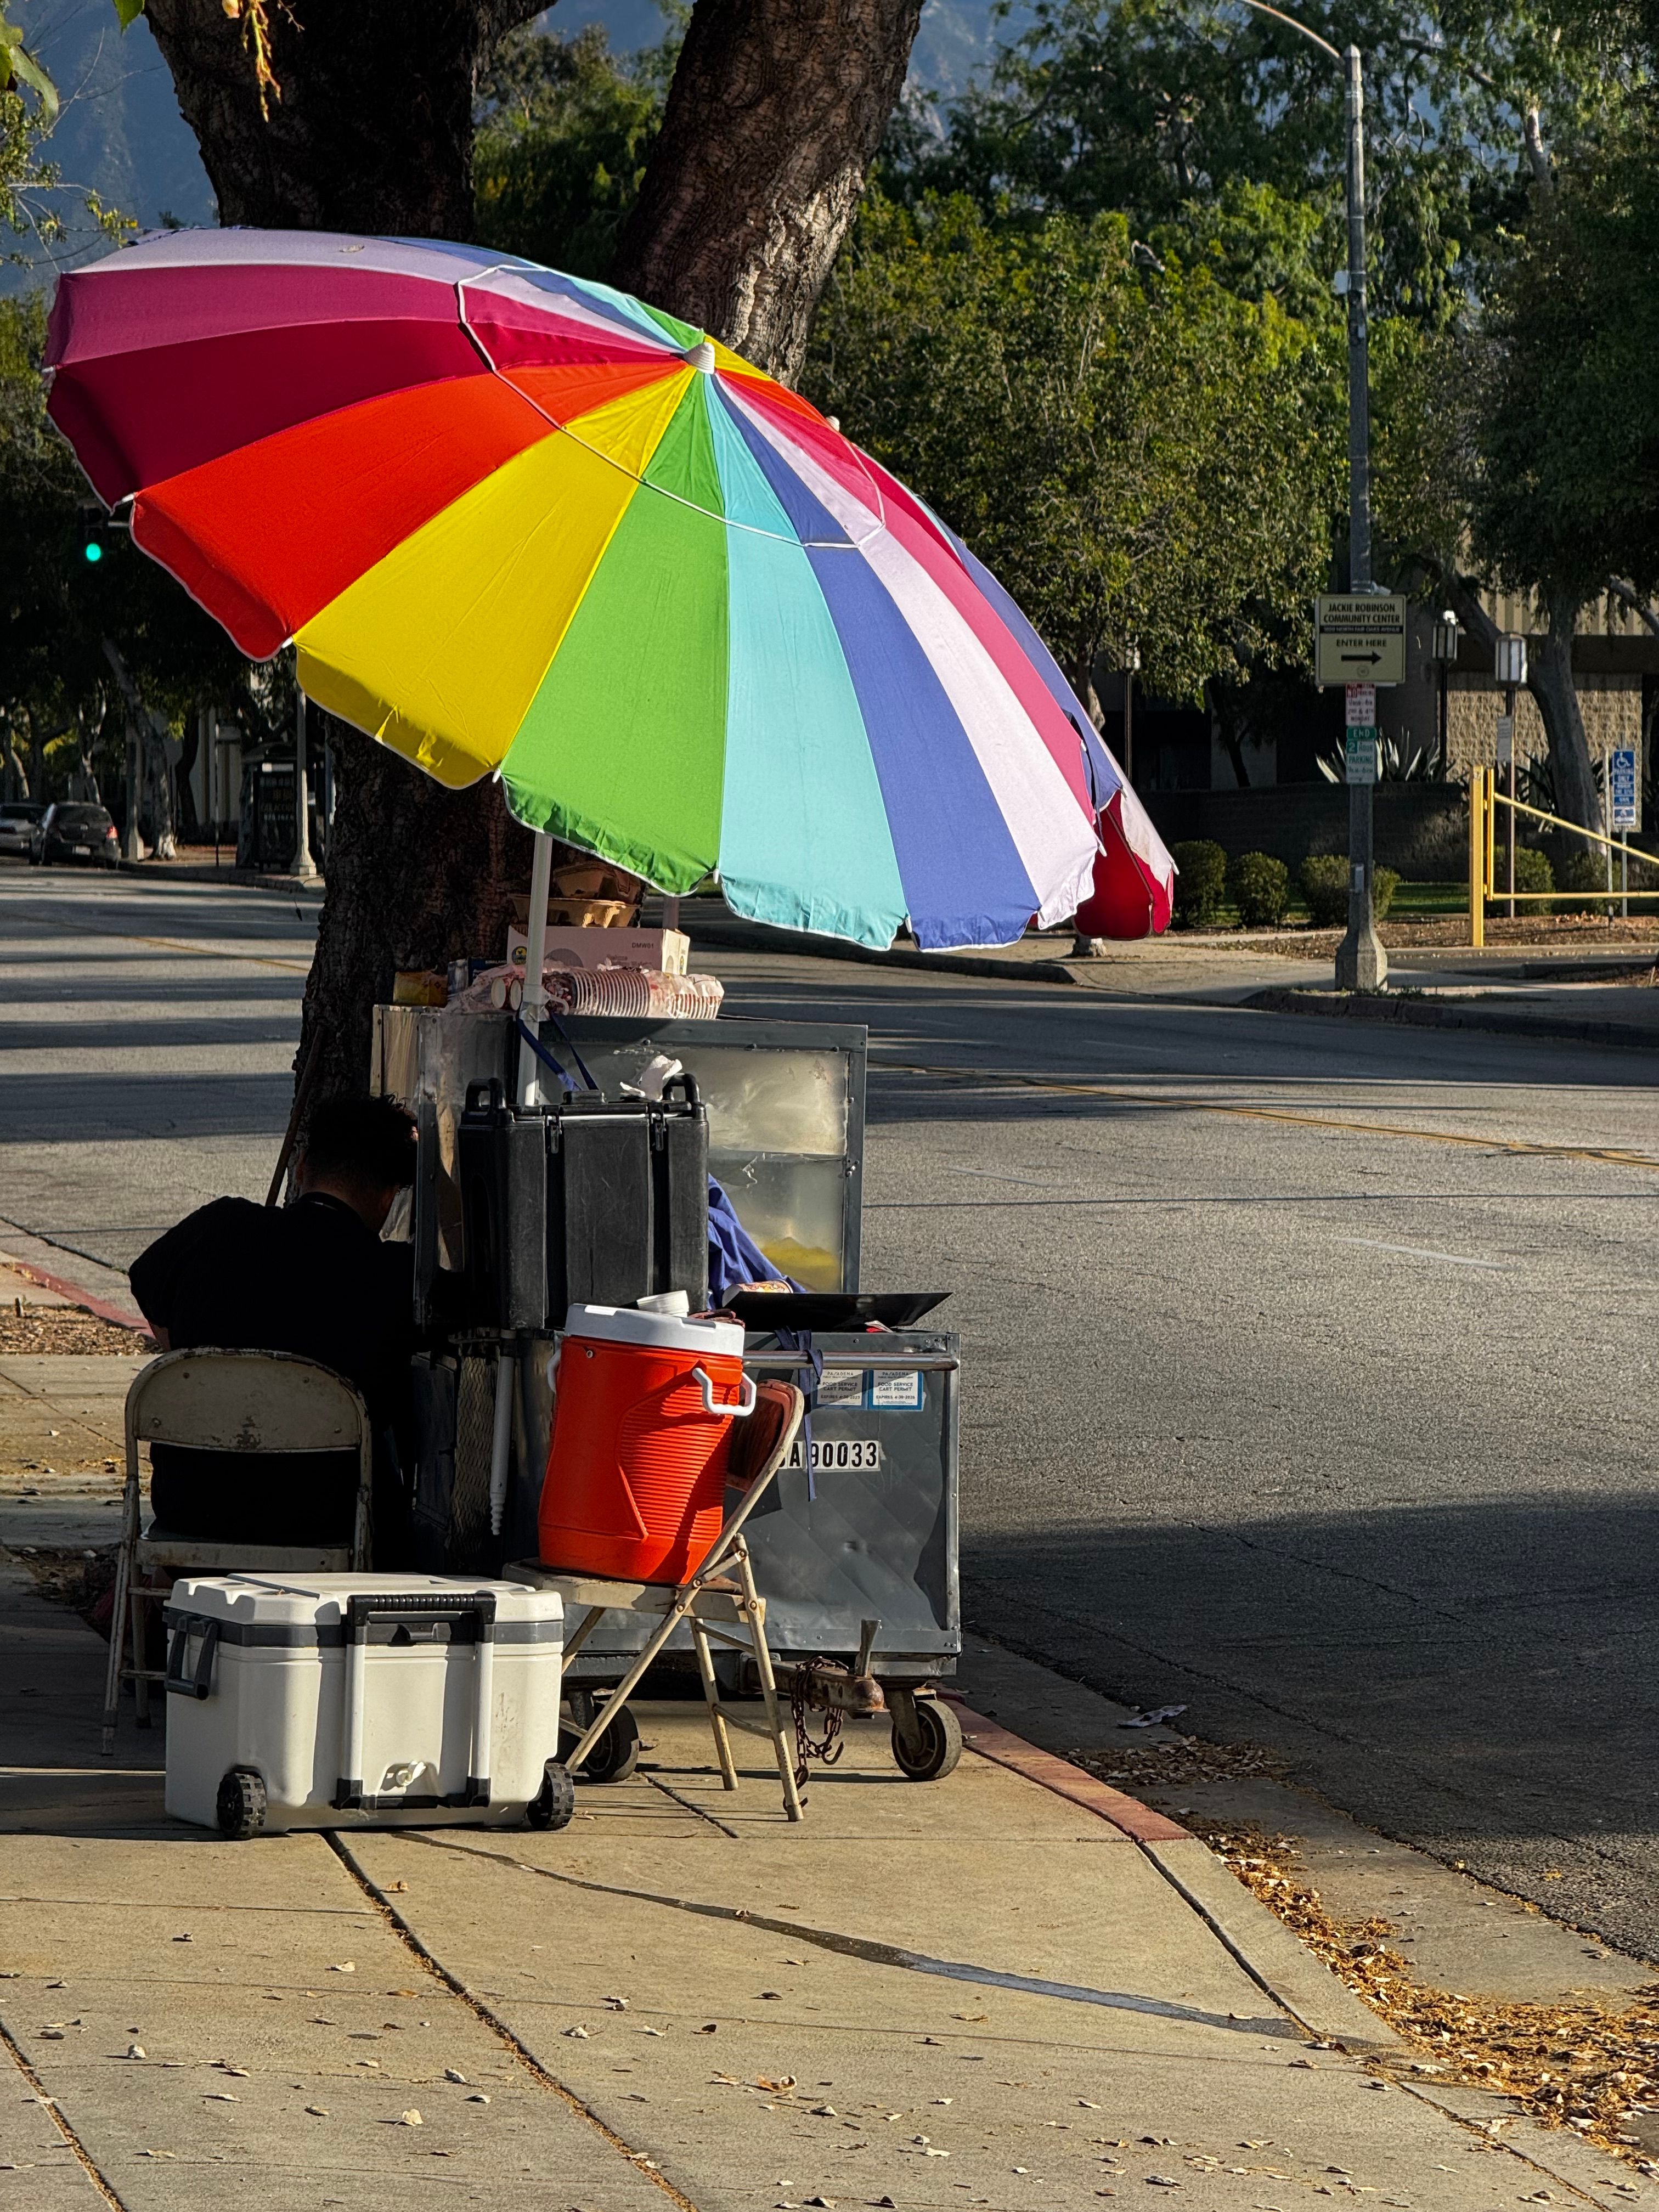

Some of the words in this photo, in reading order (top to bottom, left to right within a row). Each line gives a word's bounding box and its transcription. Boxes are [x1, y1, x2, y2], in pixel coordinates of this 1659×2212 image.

[1328, 603, 1352, 612] JACKIE
[1355, 603, 1395, 612] ROBINSON
[1324, 614, 1370, 623] COMMUNITY
[1373, 614, 1400, 623] CENTER
[1353, 729, 1370, 738] END
[1349, 742, 1356, 752] 2
[1348, 755, 1373, 764] PARKING
[811, 1442, 877, 1468] 90033
